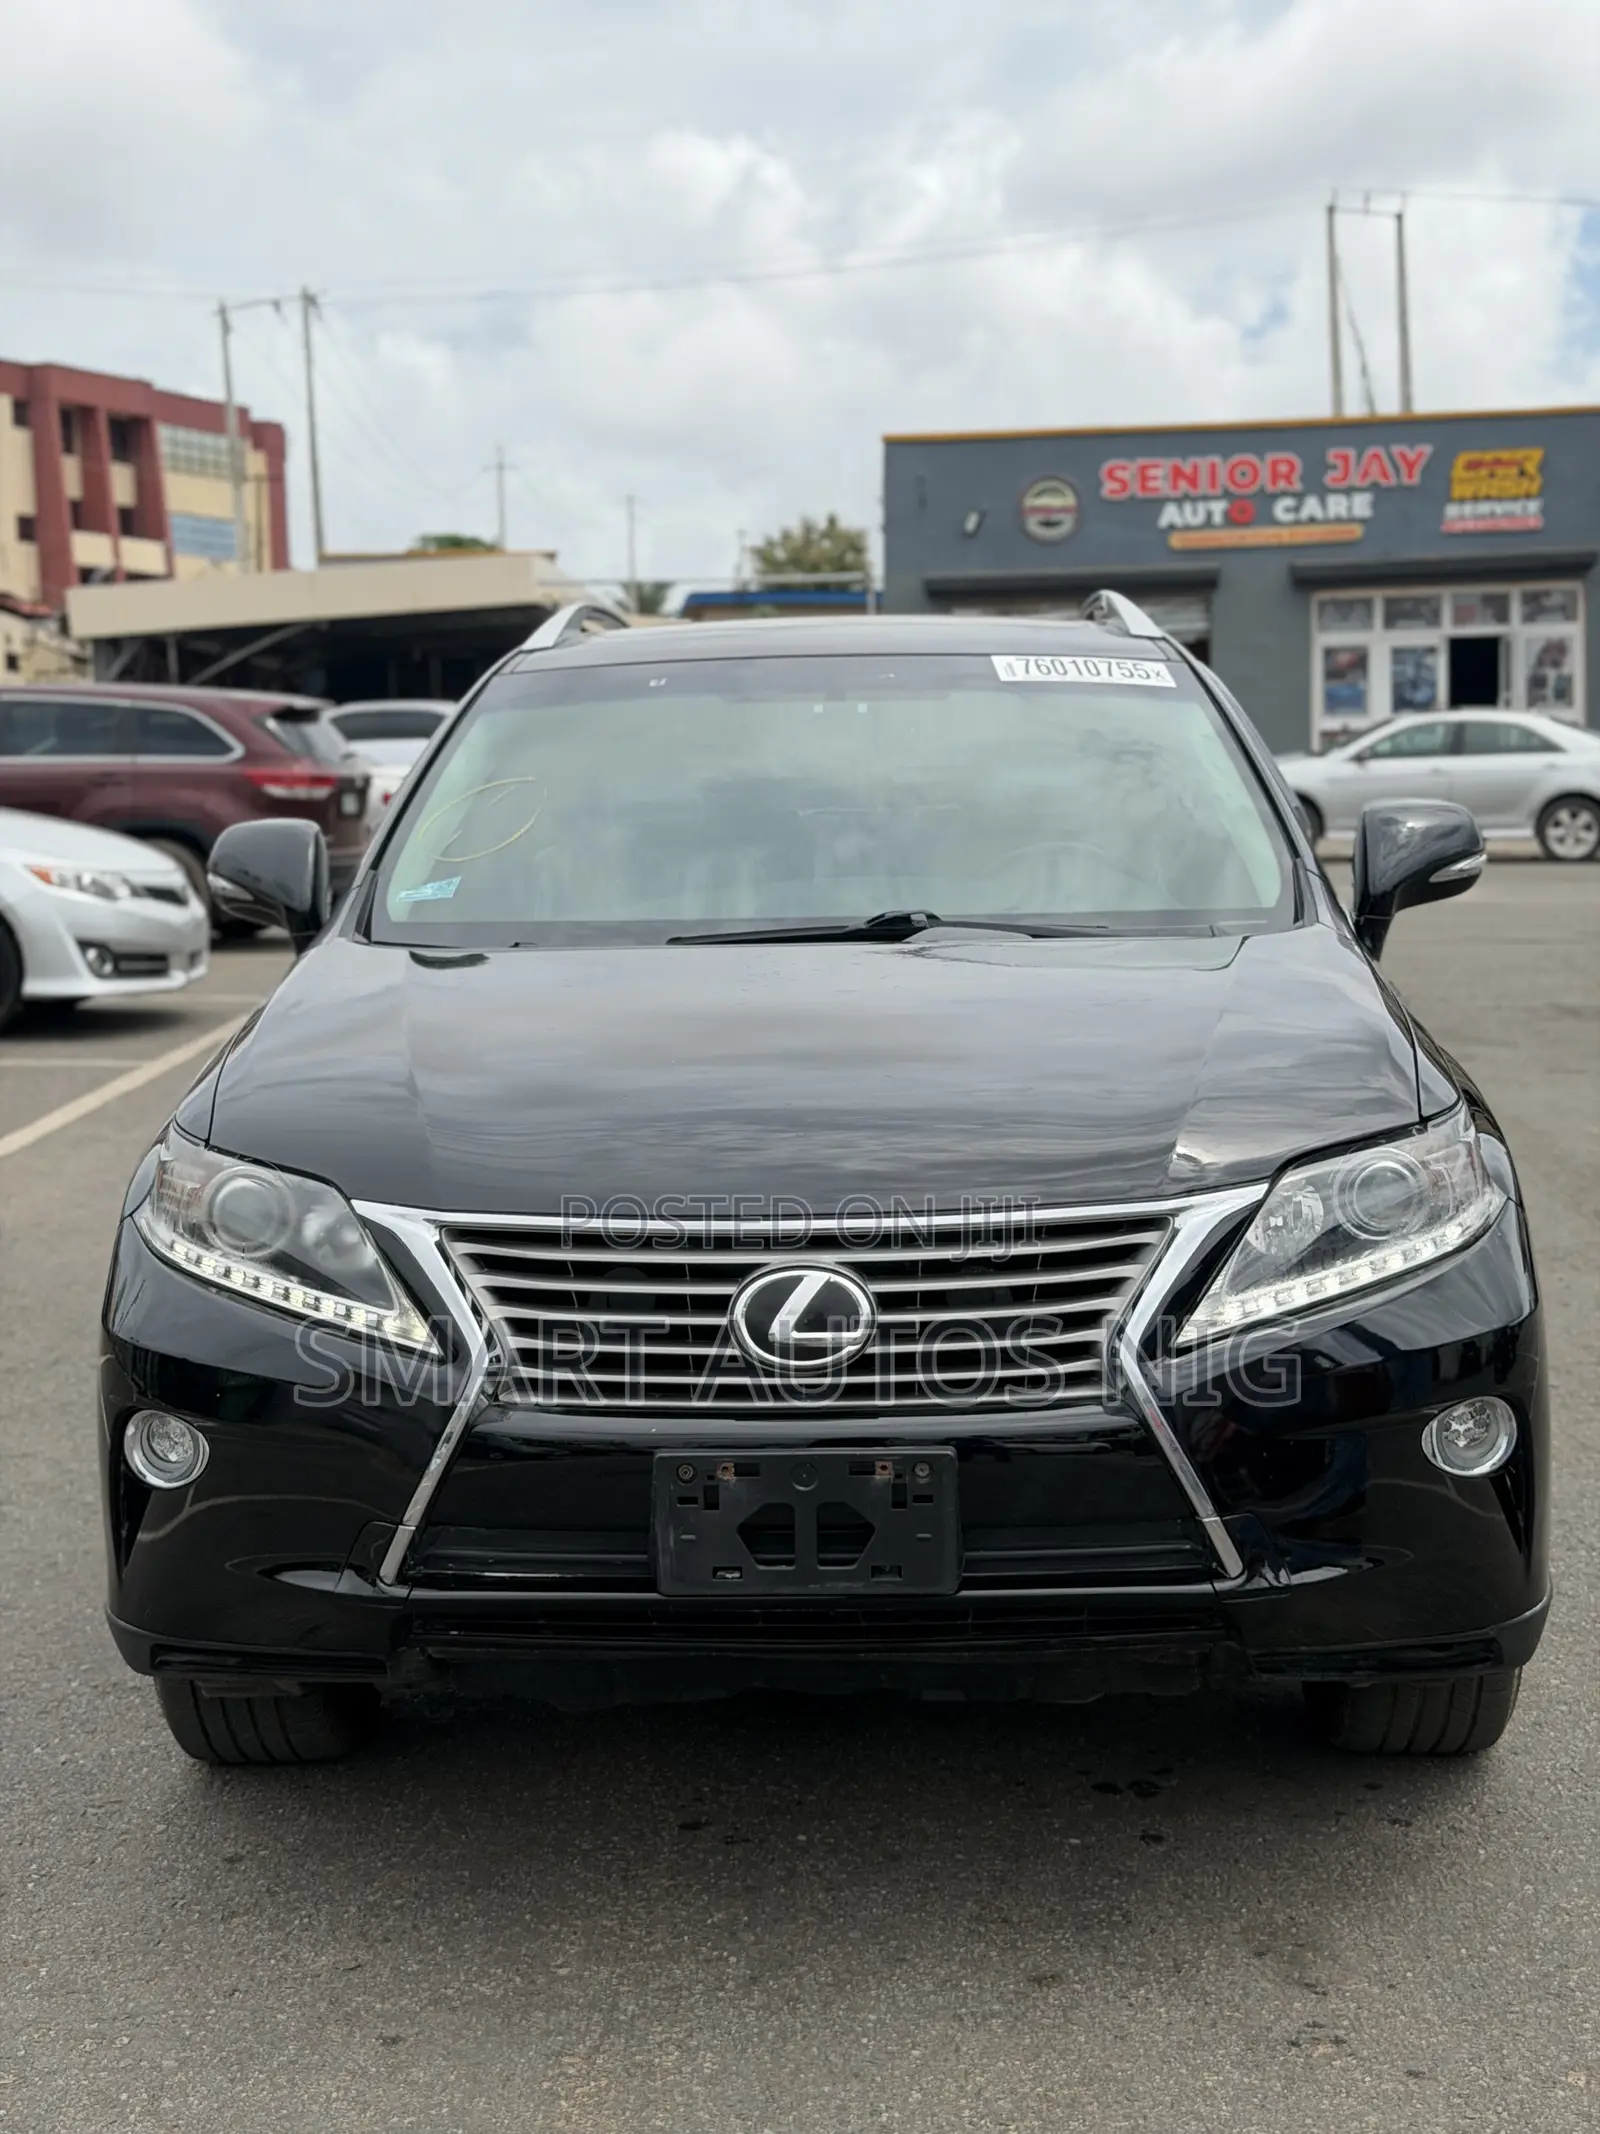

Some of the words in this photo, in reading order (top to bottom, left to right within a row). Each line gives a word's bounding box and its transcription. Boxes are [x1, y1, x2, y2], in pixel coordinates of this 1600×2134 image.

[1100, 454, 1304, 497] SENIOR
[1323, 444, 1433, 488] JAY
[1157, 499, 1257, 529] AUTO
[1271, 493, 1374, 522] CARE
